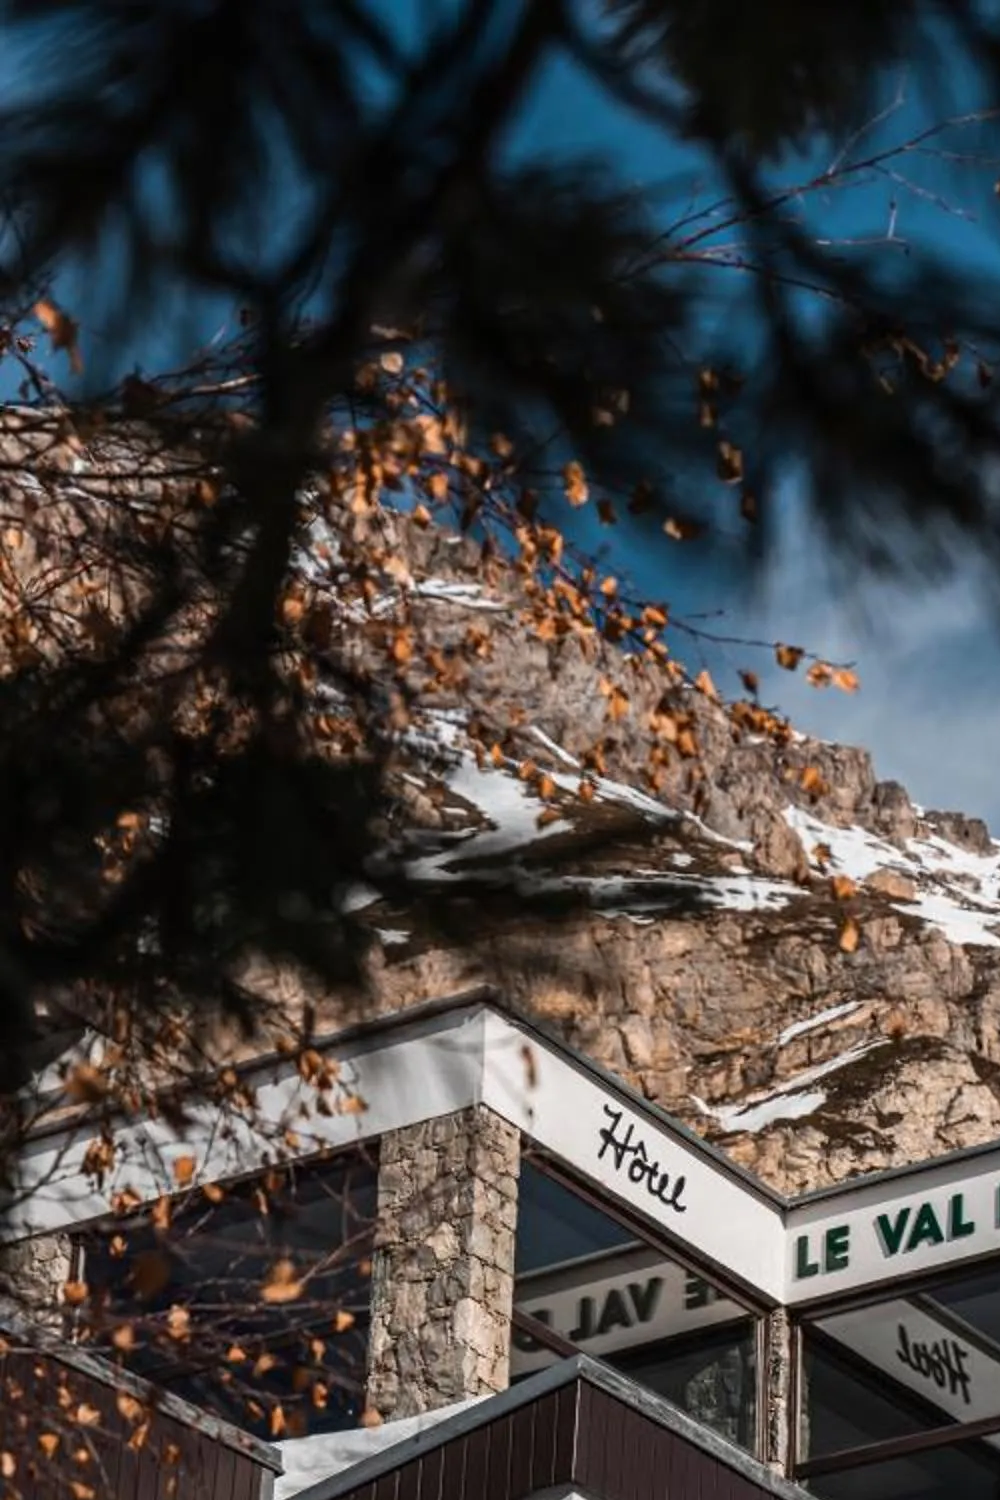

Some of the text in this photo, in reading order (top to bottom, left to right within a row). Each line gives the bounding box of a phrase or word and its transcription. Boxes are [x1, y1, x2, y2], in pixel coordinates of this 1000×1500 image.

[598, 1104, 686, 1213] Hôtel
[793, 1225, 850, 1282] LE
[877, 1201, 976, 1258] VAL
